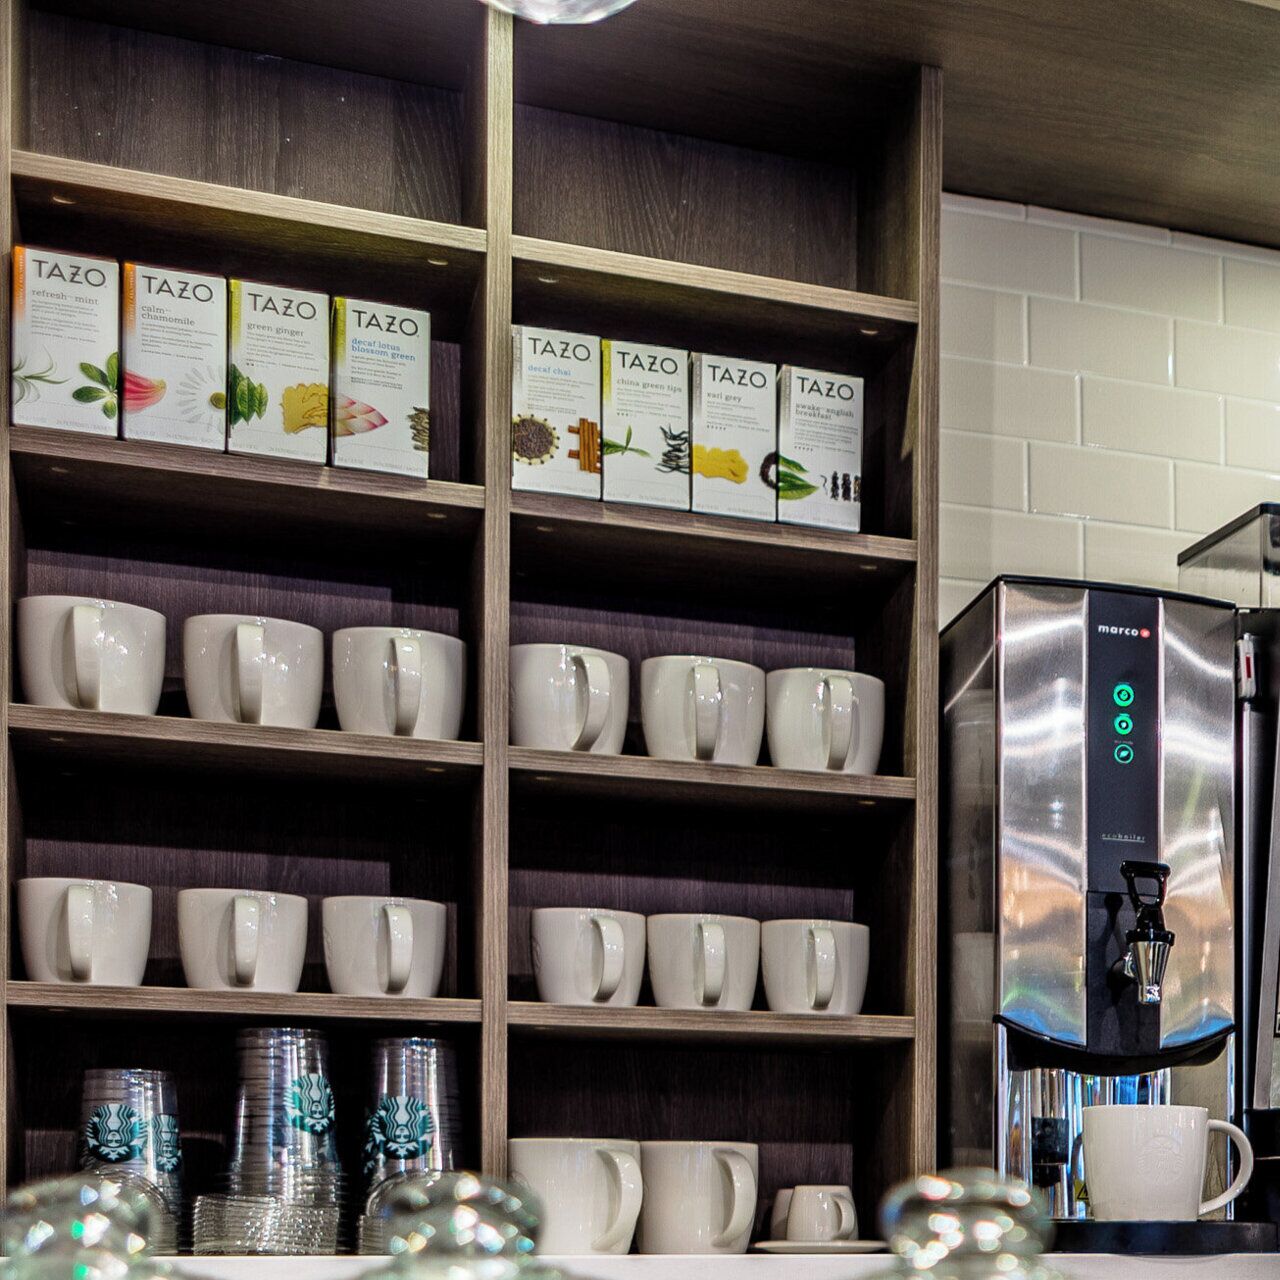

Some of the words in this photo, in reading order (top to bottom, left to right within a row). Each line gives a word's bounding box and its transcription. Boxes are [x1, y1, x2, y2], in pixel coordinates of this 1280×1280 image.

[32, 259, 106, 287] TAZO
[142, 275, 213, 302] TAZO
[74, 293, 99, 305] mint
[248, 293, 316, 320] TAZO
[141, 312, 195, 326] chamomile
[352, 310, 418, 336] TAZO
[247, 323, 273, 334] green
[276, 326, 304, 338] ginger
[351, 338, 376, 348] decaf
[378, 341, 401, 351] lotus
[528, 337, 591, 361] TAZO
[351, 344, 388, 356] blossom
[391, 350, 416, 362] green
[528, 364, 551, 374] decaf
[553, 367, 571, 377] chai
[617, 351, 678, 375] TAZO
[707, 364, 767, 388] TAZO
[617, 378, 639, 387] china
[642, 381, 665, 391] green
[667, 383, 682, 393] tips
[797, 376, 854, 401] TAZO
[725, 394, 742, 403] grey
[796, 409, 832, 420] breakfast
[1098, 625, 1139, 636] marco
